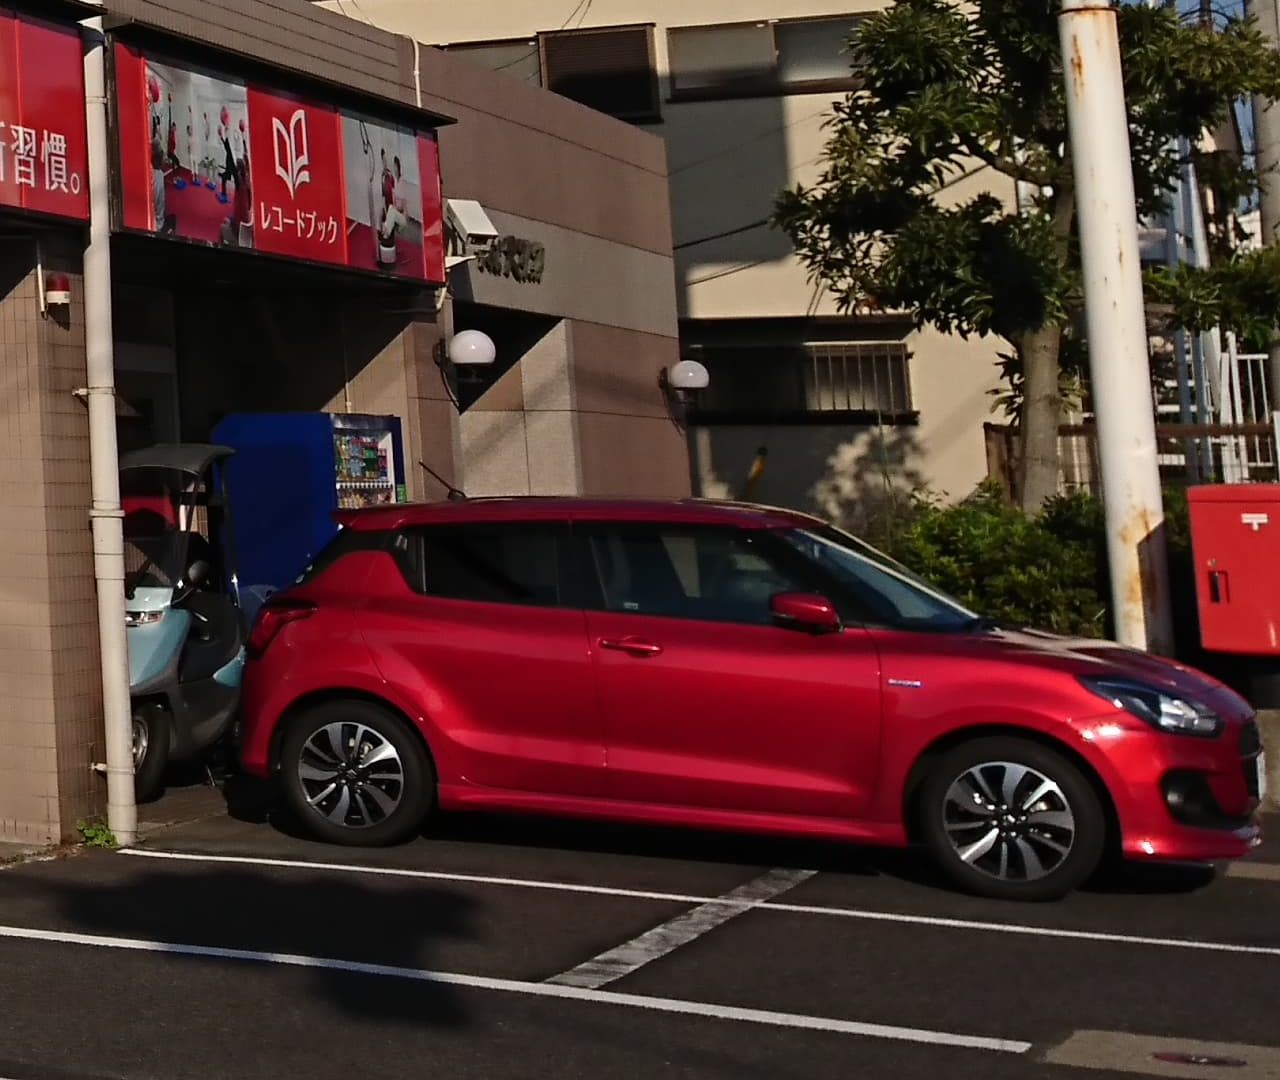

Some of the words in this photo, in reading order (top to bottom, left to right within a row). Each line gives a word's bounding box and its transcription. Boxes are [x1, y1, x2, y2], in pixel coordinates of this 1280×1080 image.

[259, 201, 339, 247] レコードブック
